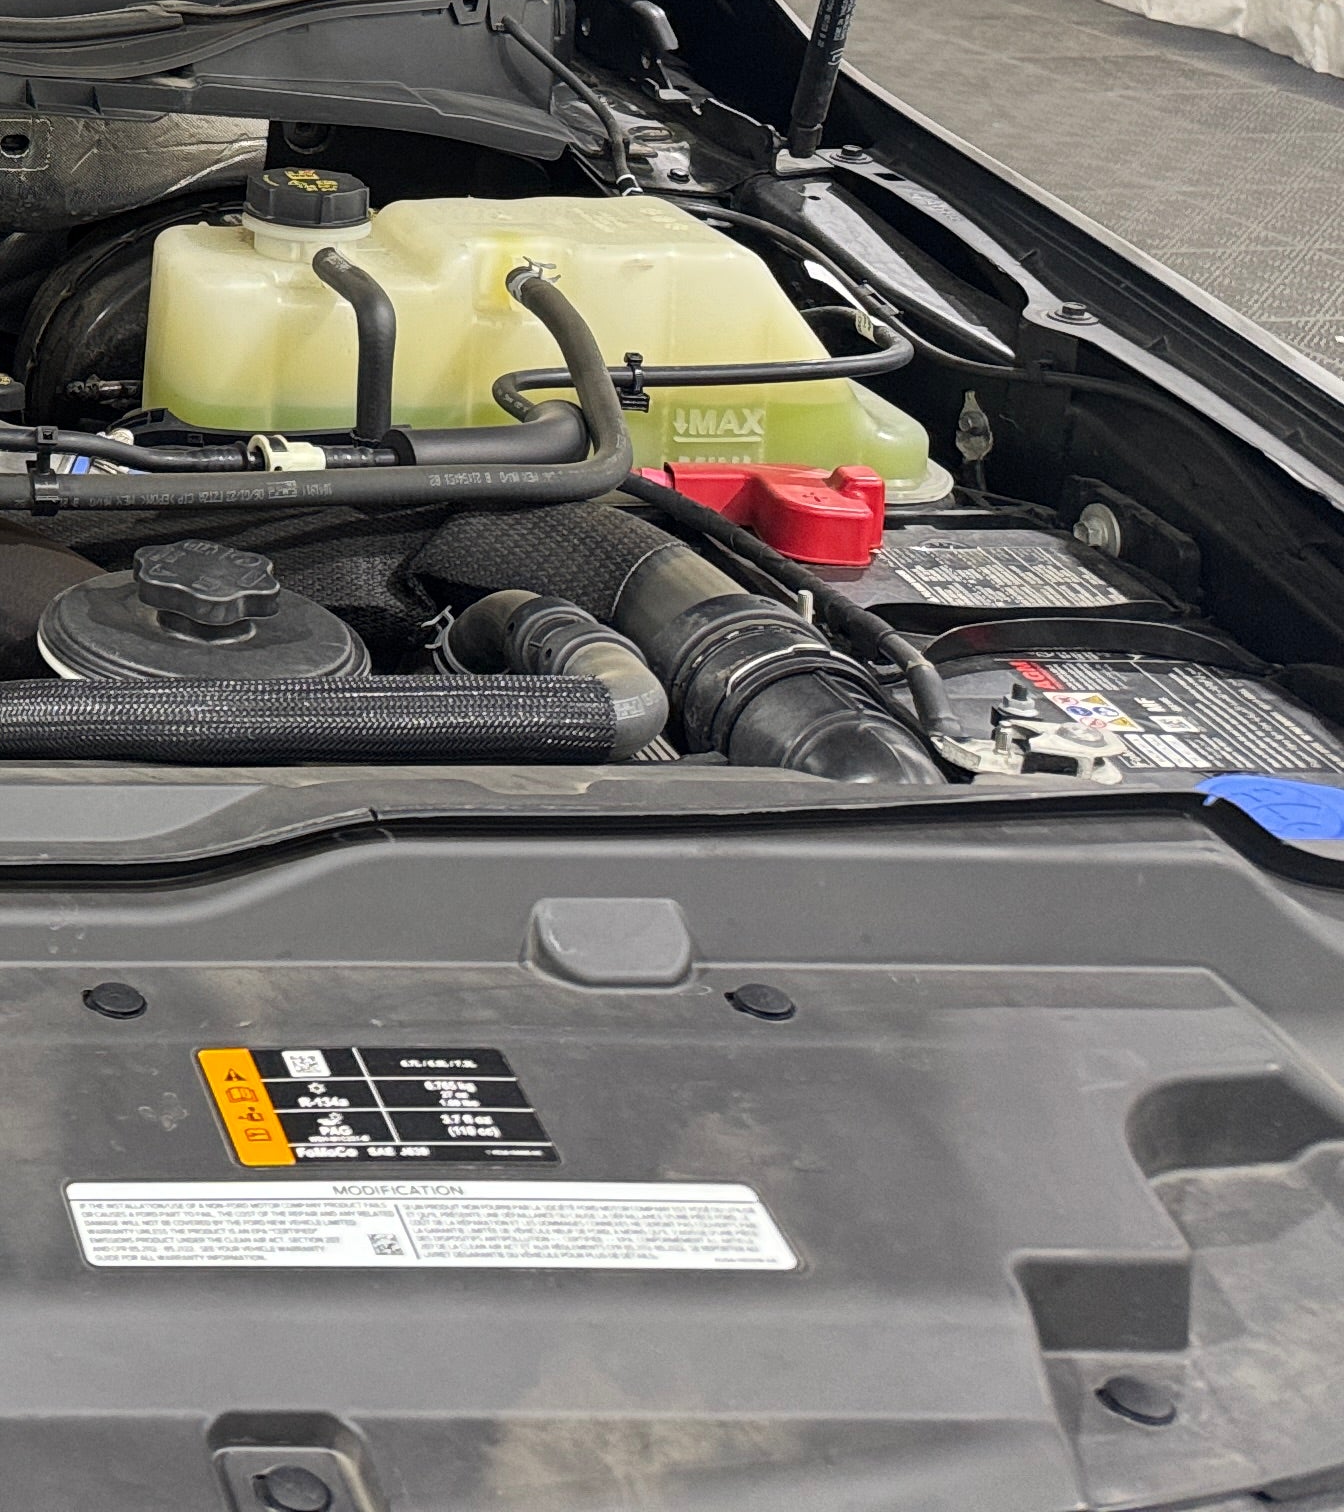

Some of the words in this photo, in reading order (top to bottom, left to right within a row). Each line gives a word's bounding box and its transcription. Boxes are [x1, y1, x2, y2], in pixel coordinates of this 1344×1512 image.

[689, 407, 765, 435] MAX
[318, 1124, 353, 1135] PAG
[295, 1147, 359, 1157] FoMoCo
[332, 1185, 463, 1195] MODIFICATION
